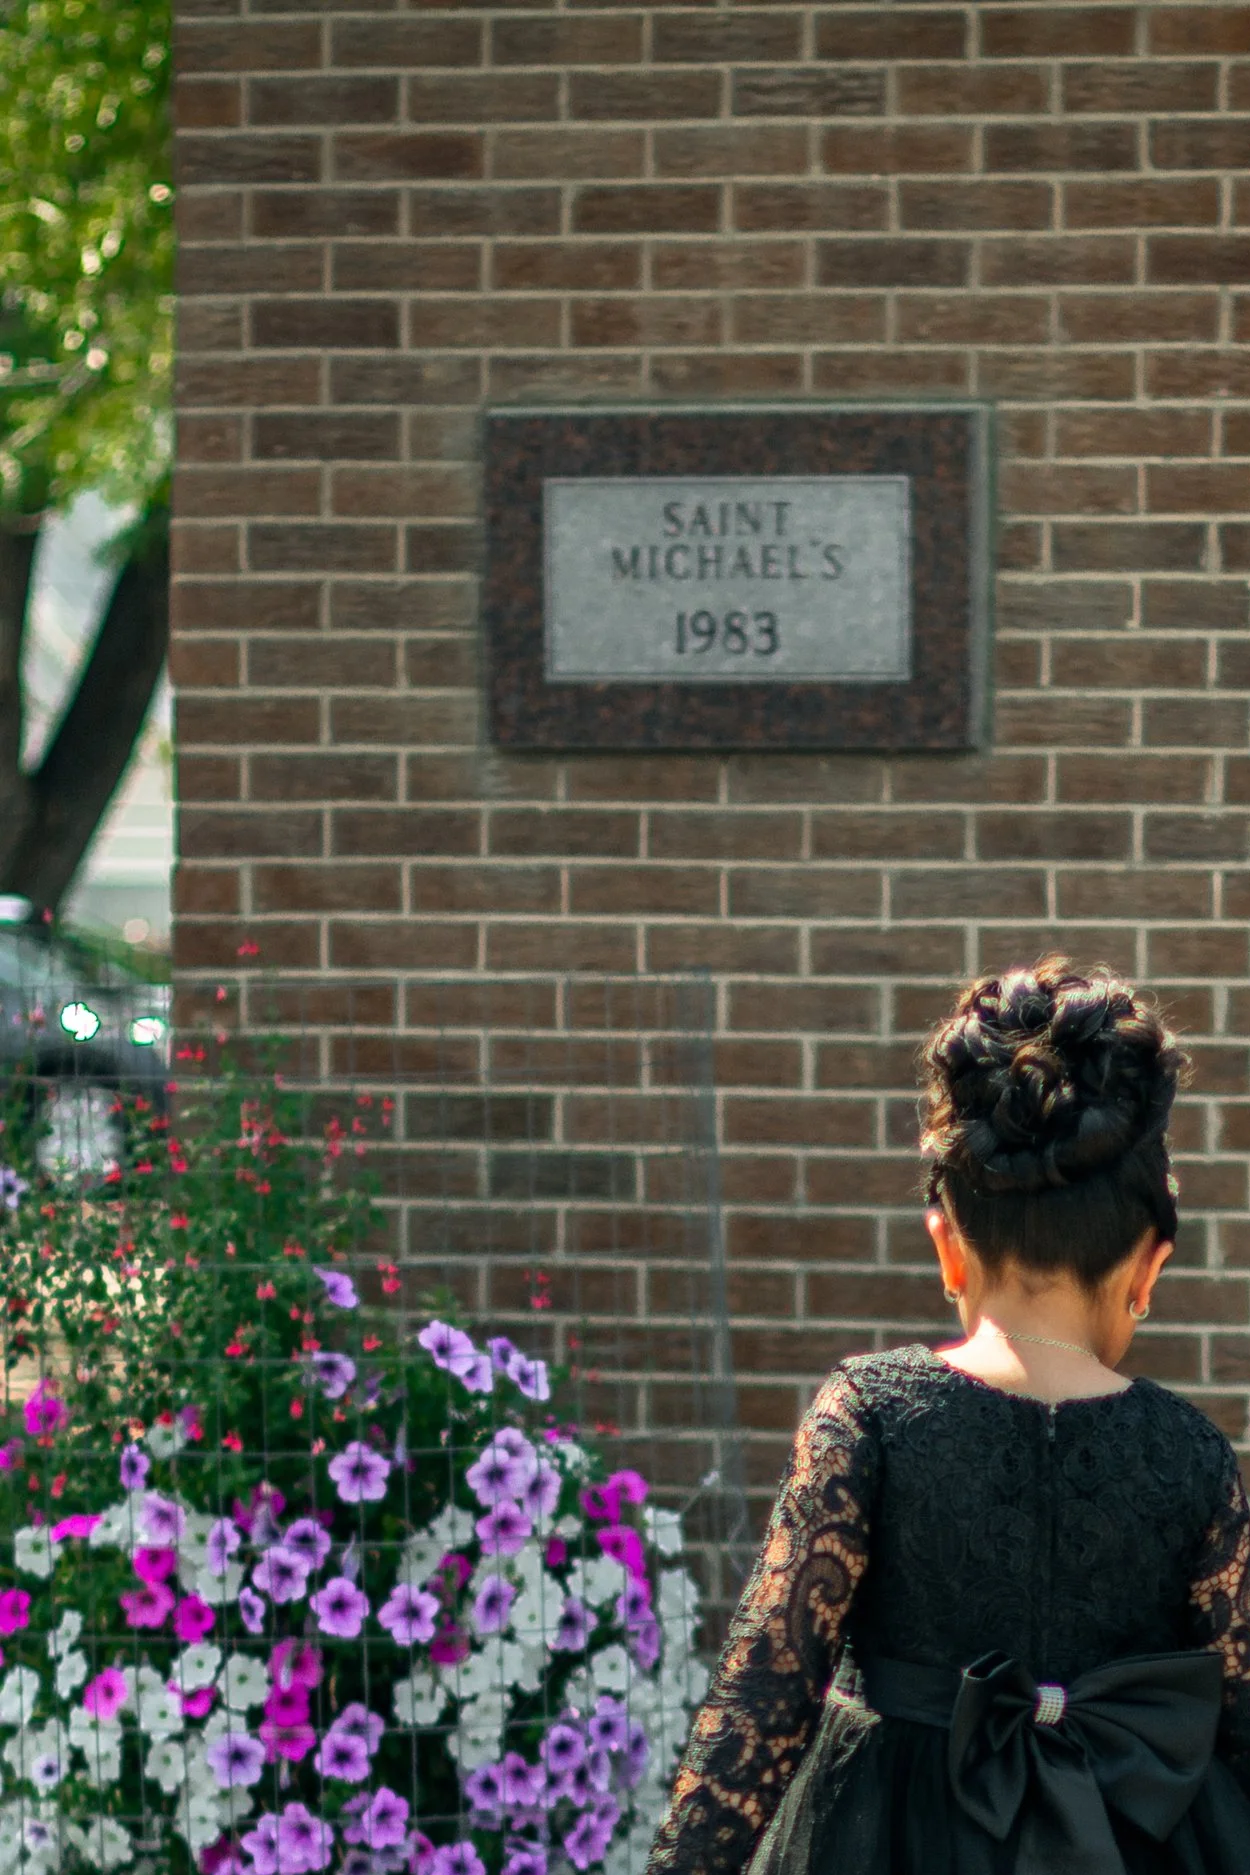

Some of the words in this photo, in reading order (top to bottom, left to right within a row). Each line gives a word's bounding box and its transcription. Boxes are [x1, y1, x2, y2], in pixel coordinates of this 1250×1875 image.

[662, 500, 792, 538] SAINT
[610, 539, 845, 581] MICHAEL'S
[674, 609, 781, 657] 1983
